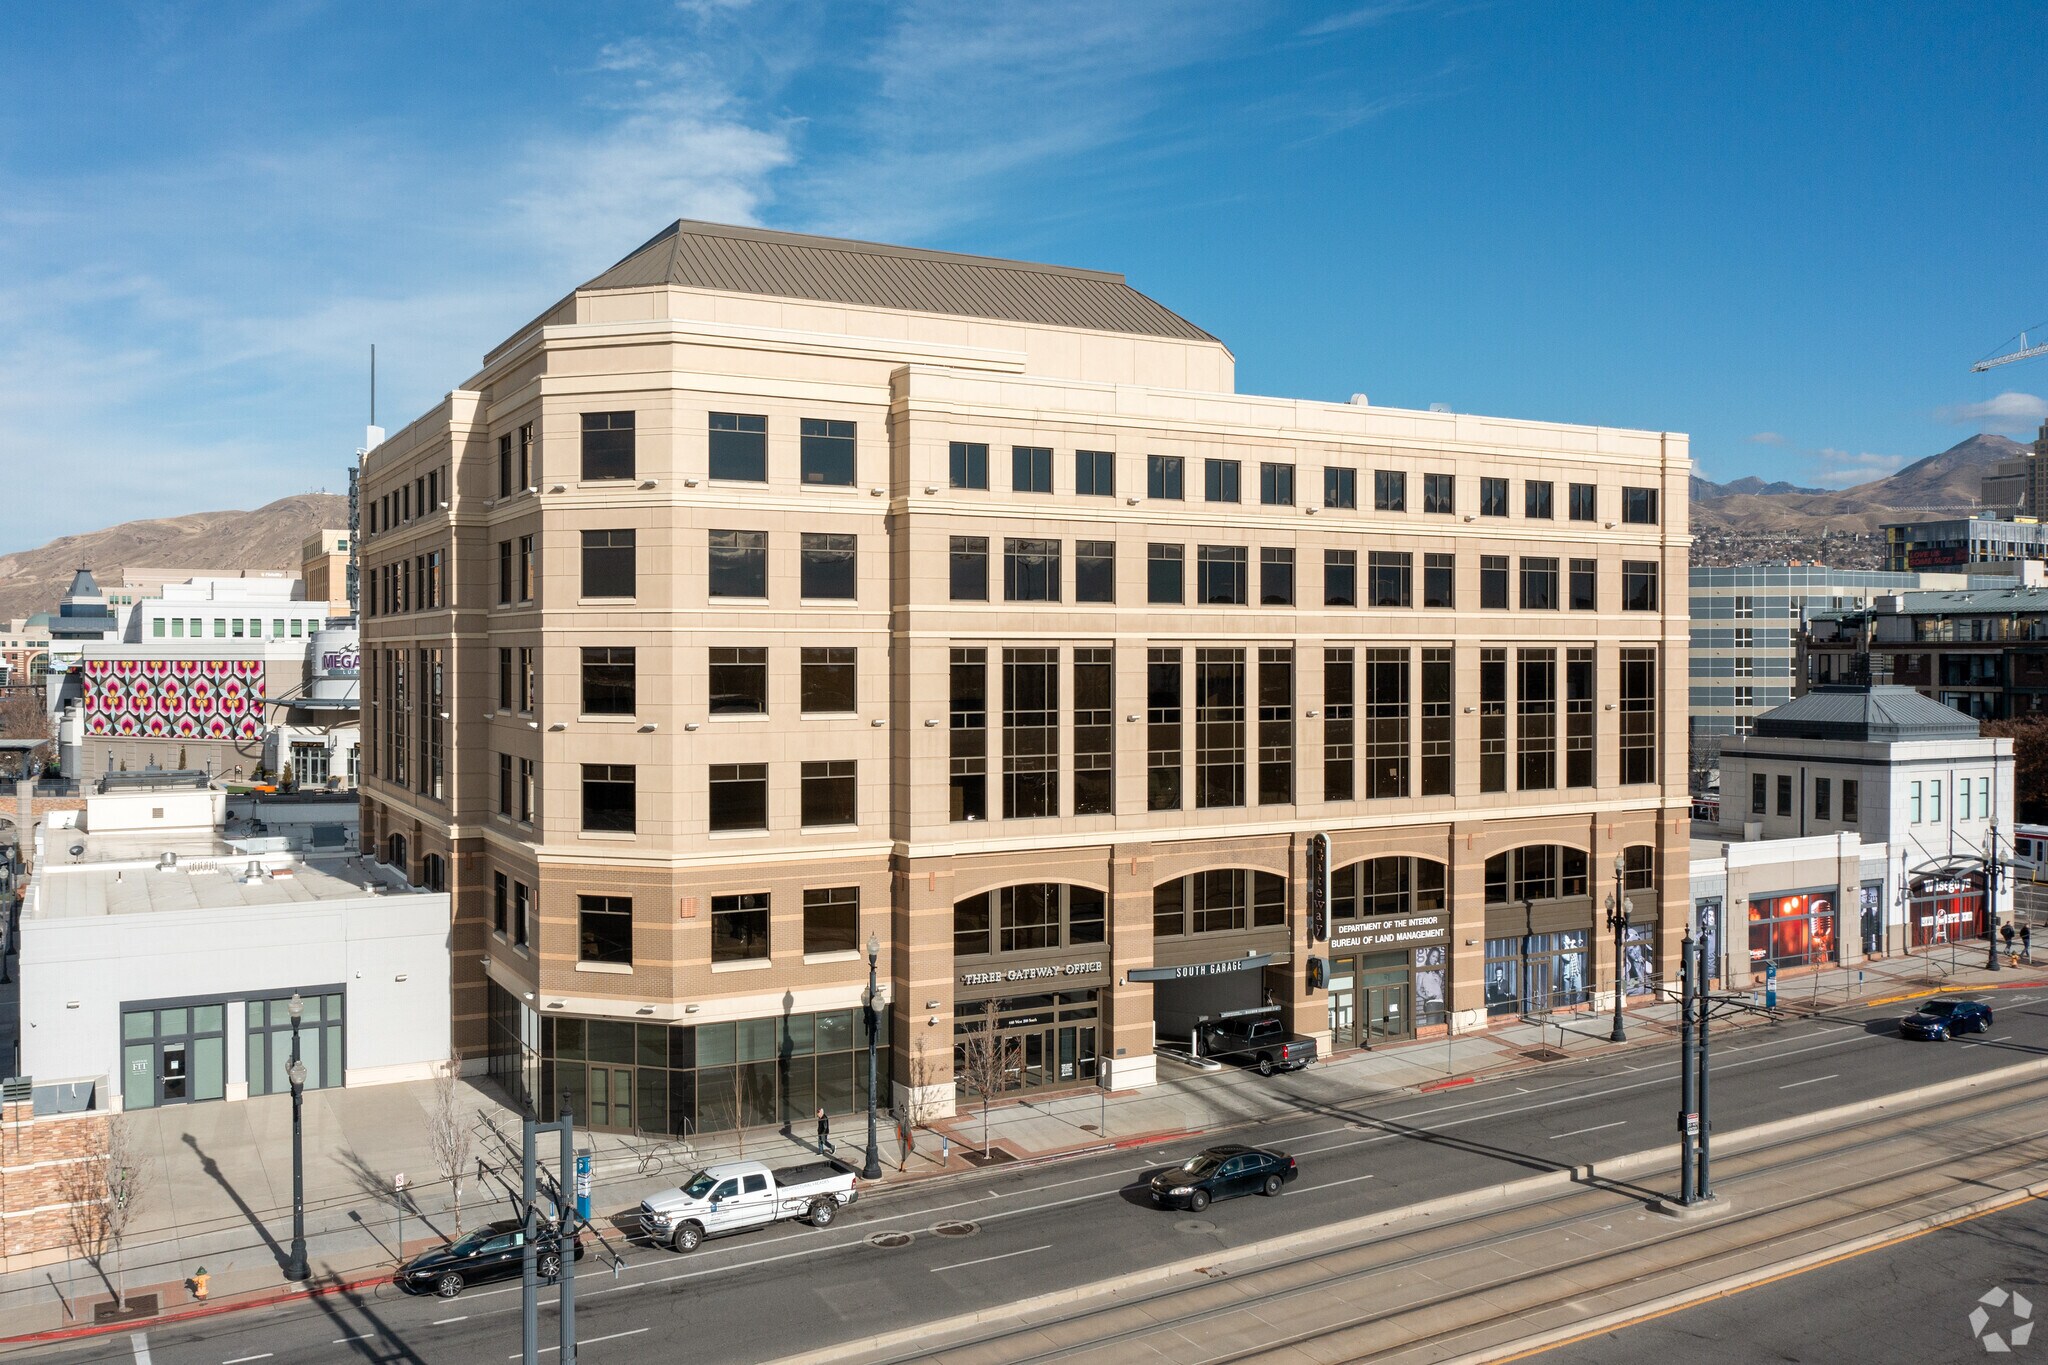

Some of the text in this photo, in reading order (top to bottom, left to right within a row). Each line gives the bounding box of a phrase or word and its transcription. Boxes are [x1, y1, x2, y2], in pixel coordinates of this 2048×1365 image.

[1909, 551, 1929, 559] LOVE
[1338, 916, 1438, 934] DEPARTMENT OF THE INTERIOR
[1331, 928, 1445, 948] BUREAU OF LAND MANAGEMENT
[965, 961, 1102, 985] THREE GATEWAY OFFICE
[1176, 961, 1242, 978] SOUTH GARAGE
